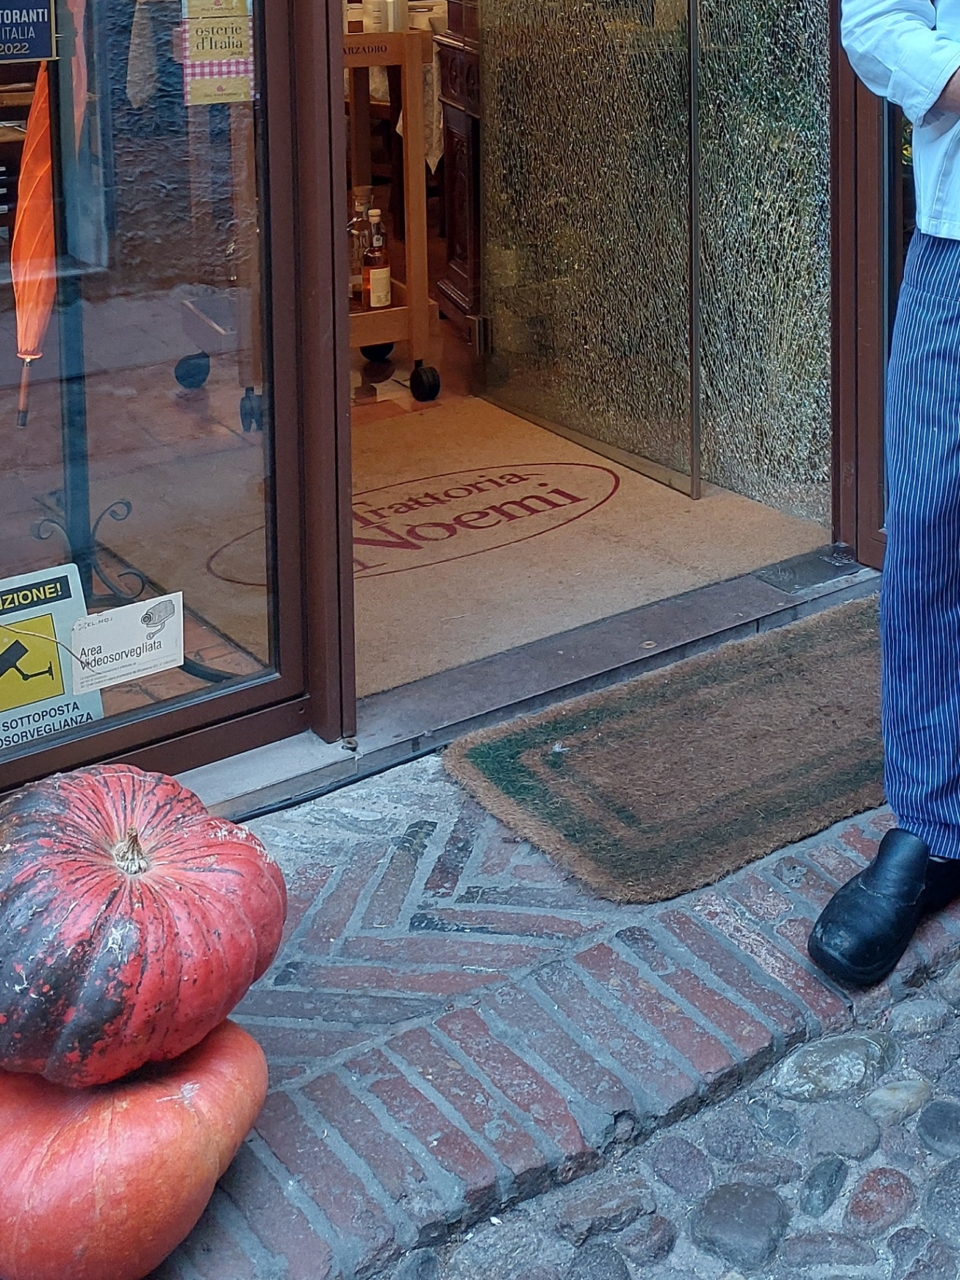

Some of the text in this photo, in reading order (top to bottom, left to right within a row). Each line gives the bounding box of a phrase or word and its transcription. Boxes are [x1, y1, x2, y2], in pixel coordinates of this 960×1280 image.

[1, 26, 36, 40] ITALIA
[195, 22, 242, 36] osterie
[0, 43, 30, 55] 2022
[196, 36, 243, 51] d'Italia
[352, 473, 546, 530] Trattoria
[353, 482, 589, 575] Noemi
[80, 645, 102, 658] Area
[80, 640, 162, 671] Videosorvegliata
[2, 701, 80, 733] SOTTOPOSTA
